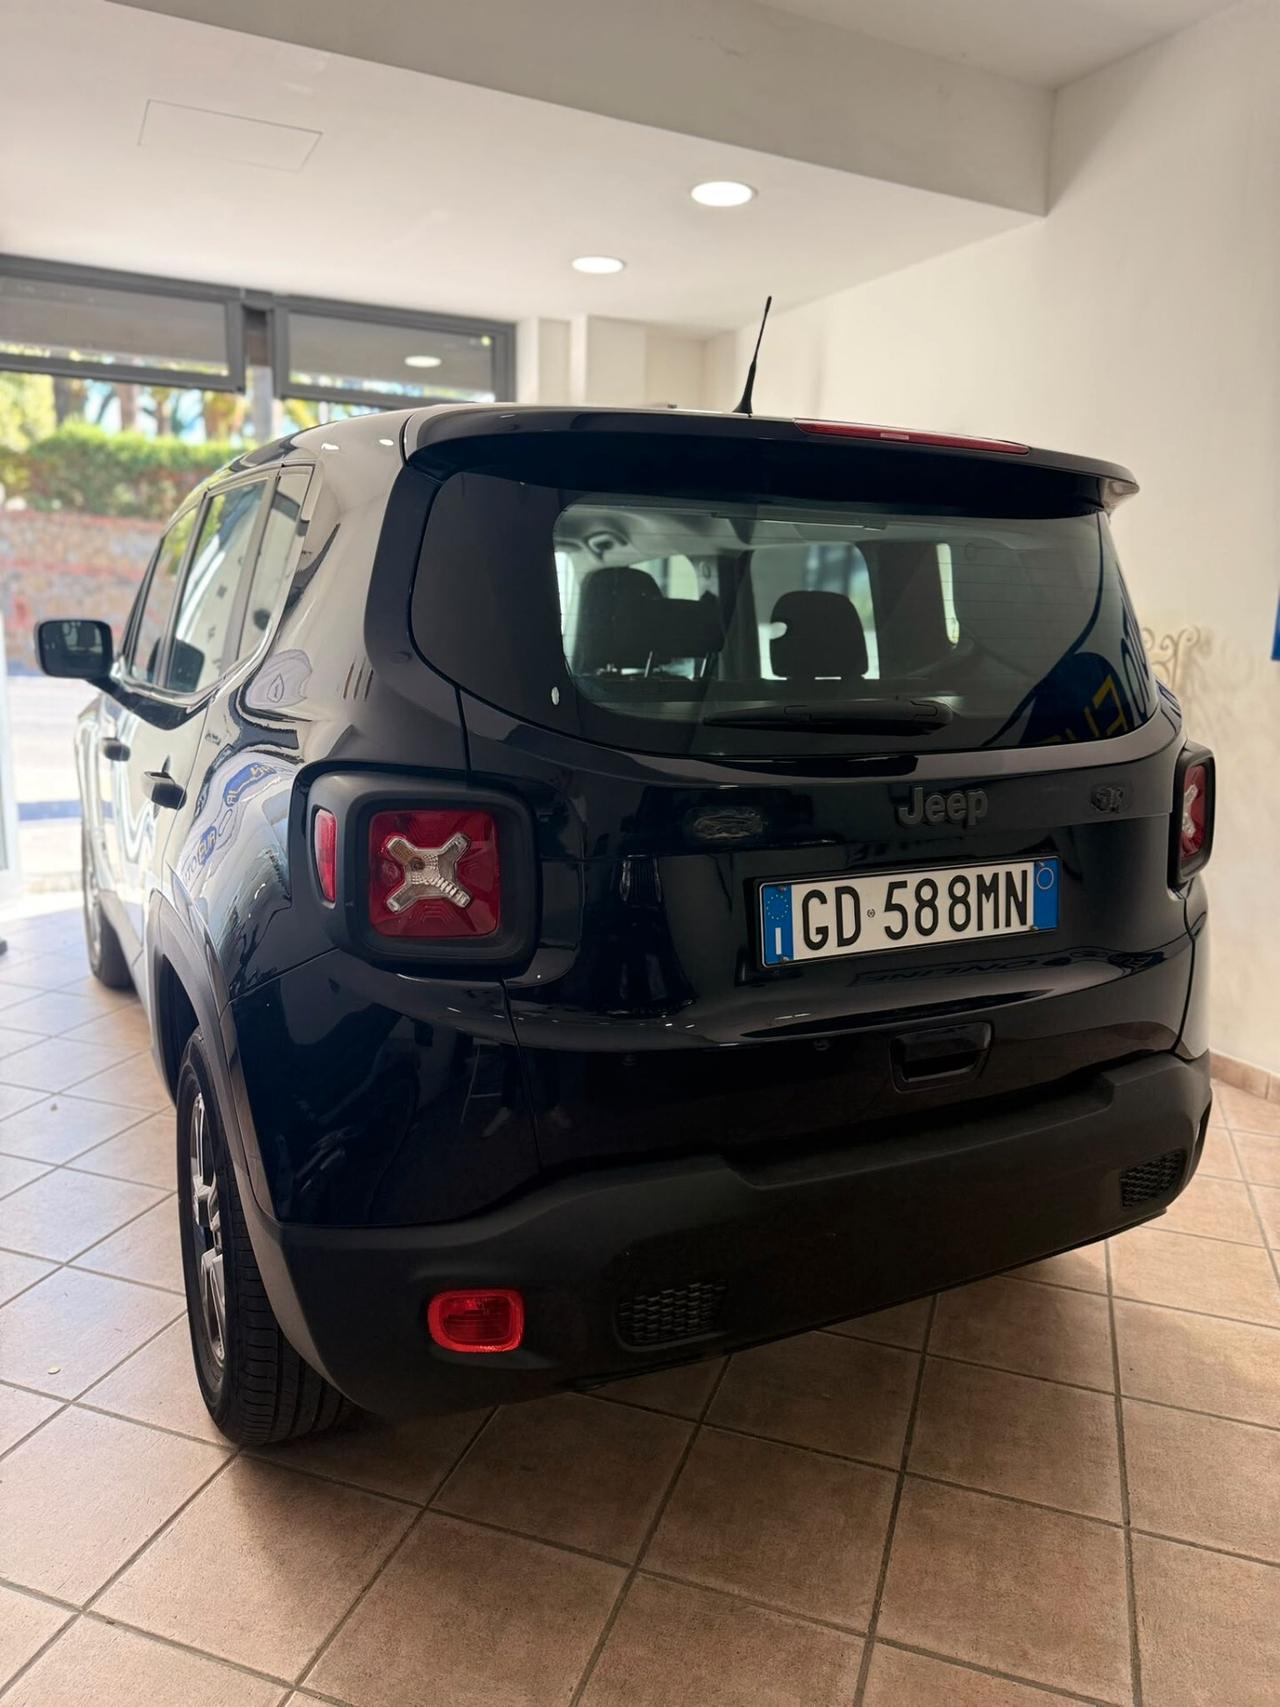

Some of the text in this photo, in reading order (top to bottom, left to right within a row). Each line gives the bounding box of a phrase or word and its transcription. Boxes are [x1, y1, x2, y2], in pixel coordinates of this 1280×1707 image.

[897, 786, 989, 827] Jeep
[801, 885, 862, 950] GD
[883, 869, 1029, 941] 588MN
